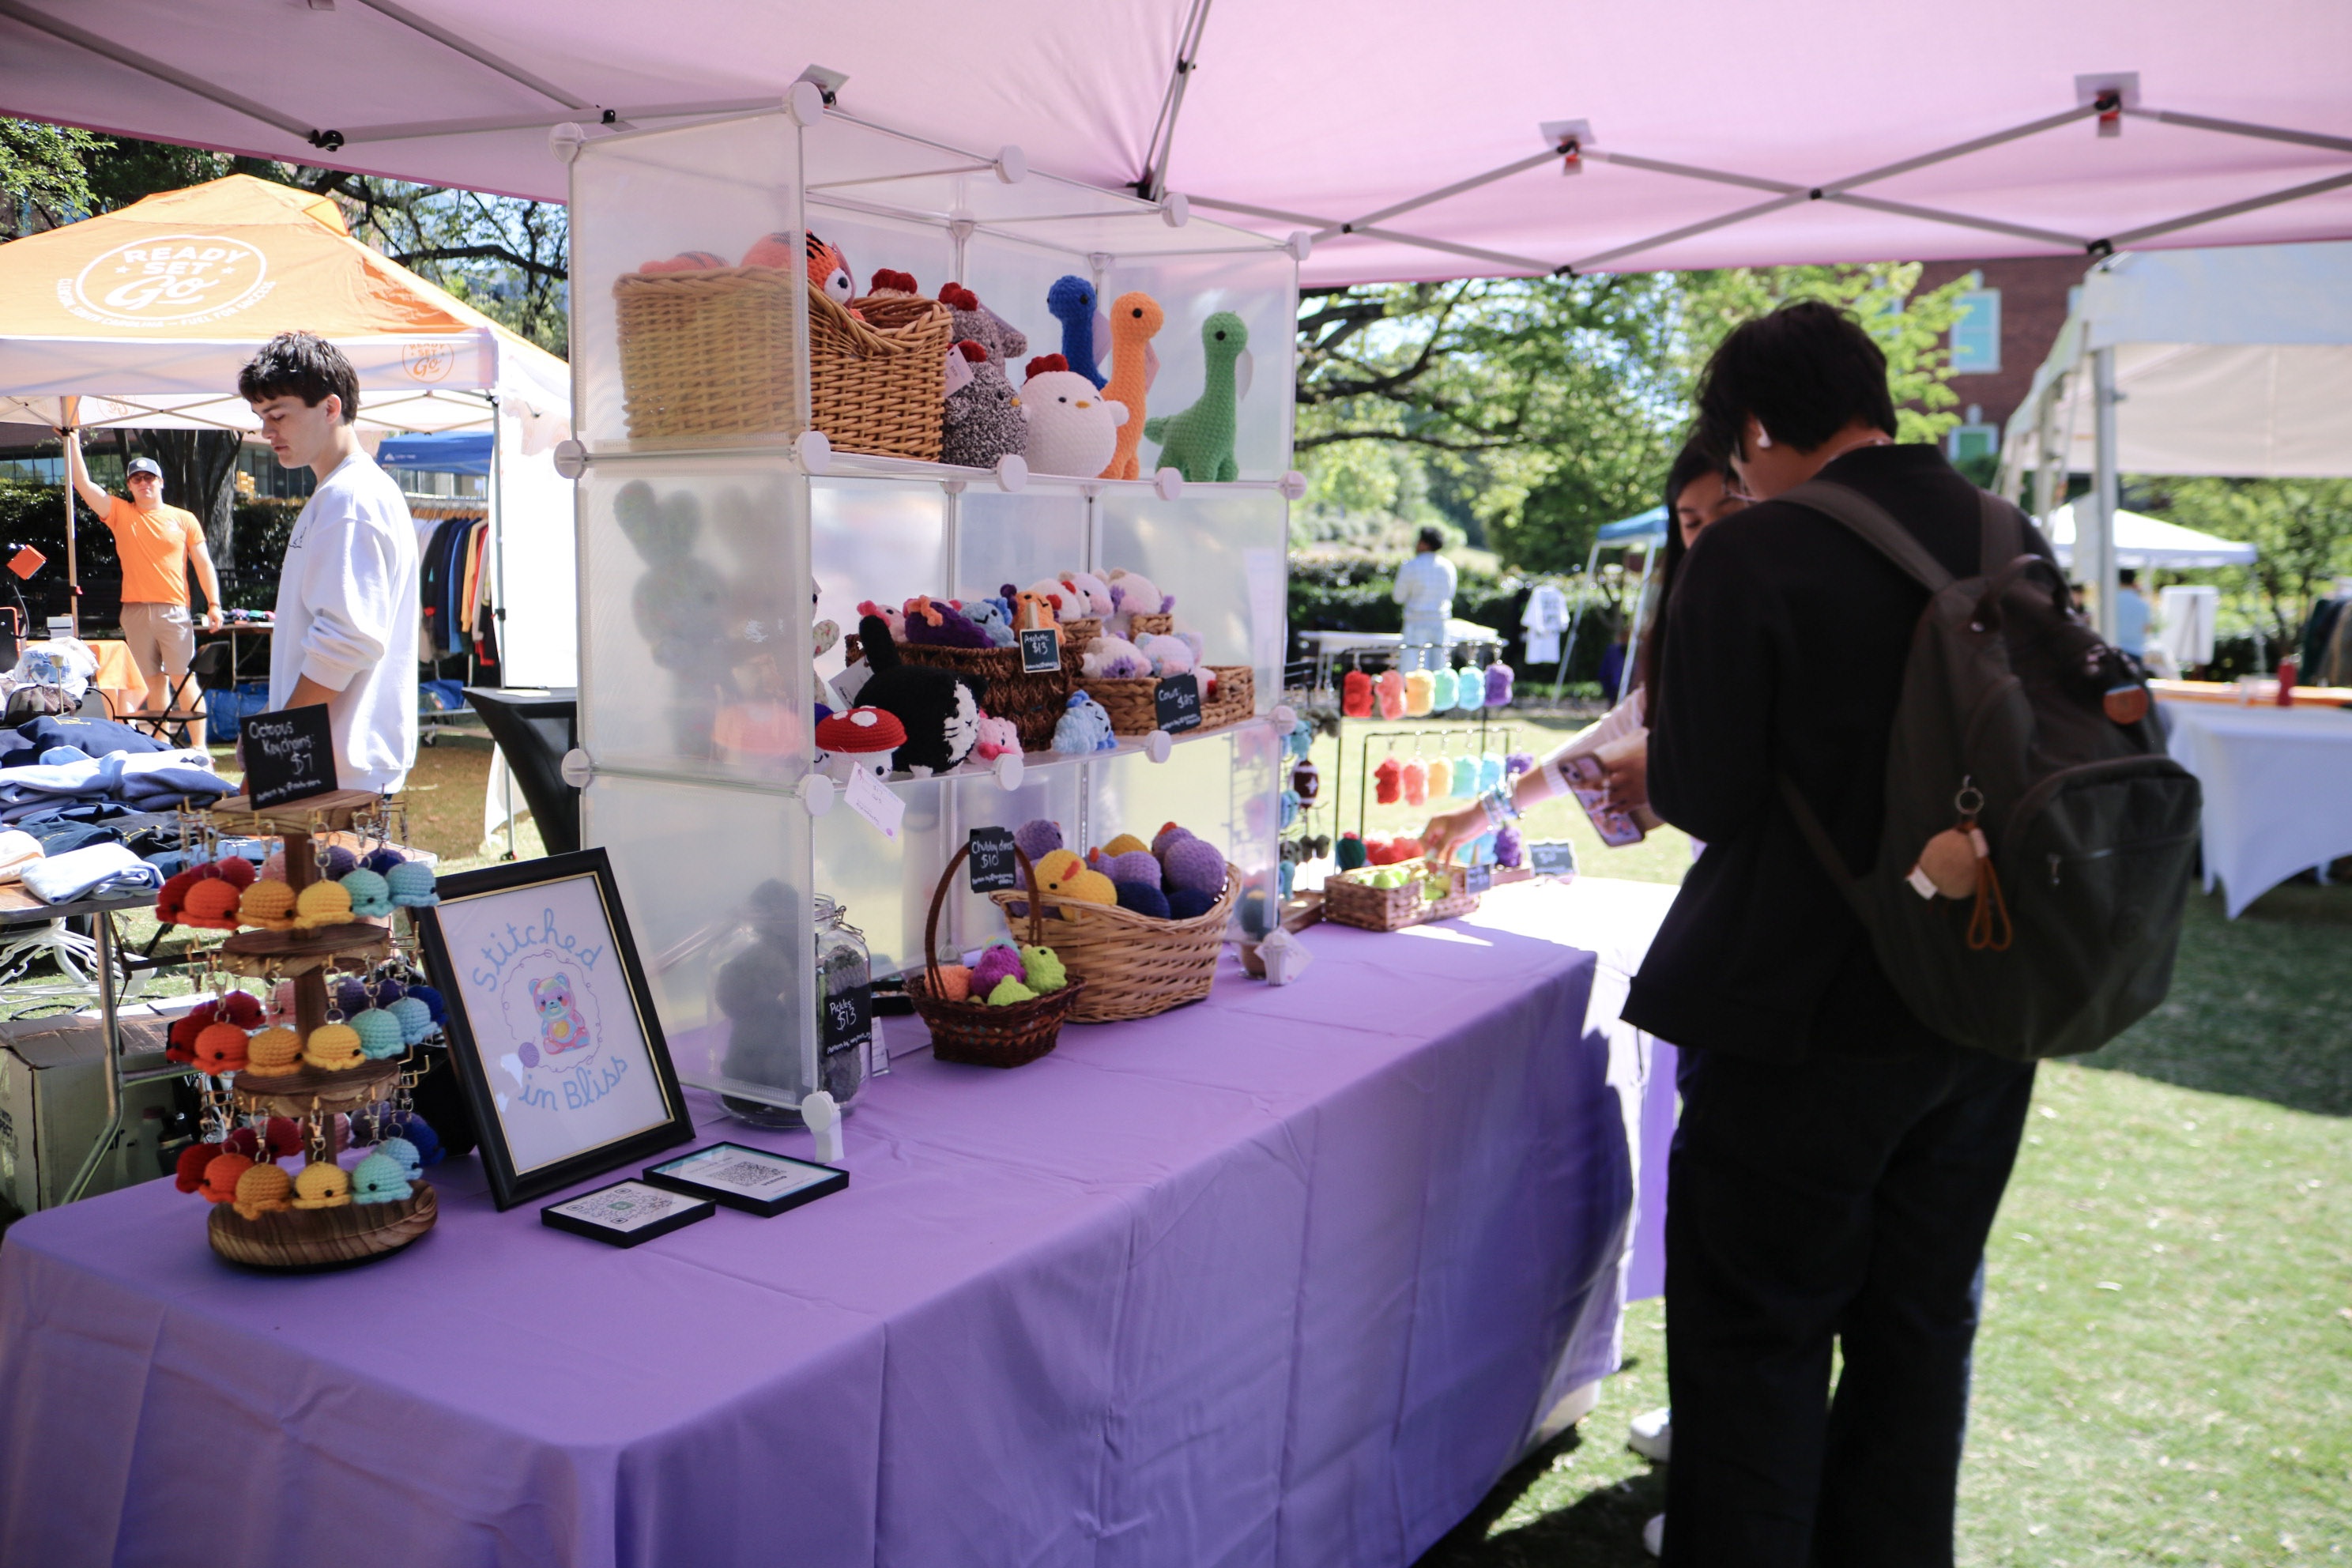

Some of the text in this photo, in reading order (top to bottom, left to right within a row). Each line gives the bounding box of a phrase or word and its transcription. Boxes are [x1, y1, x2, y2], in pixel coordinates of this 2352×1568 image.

[123, 246, 250, 264] READY
[142, 262, 213, 275] SET
[104, 275, 220, 311] Go
[413, 356, 443, 378] Go
[1032, 641, 1048, 655] $13
[248, 722, 294, 740] Octopus
[290, 752, 314, 776] $7
[971, 840, 999, 857] Chubby
[980, 854, 999, 869] $10
[473, 908, 603, 992] Stitched
[836, 1007, 857, 1031] $13
[518, 1056, 628, 1111] in Bliss
